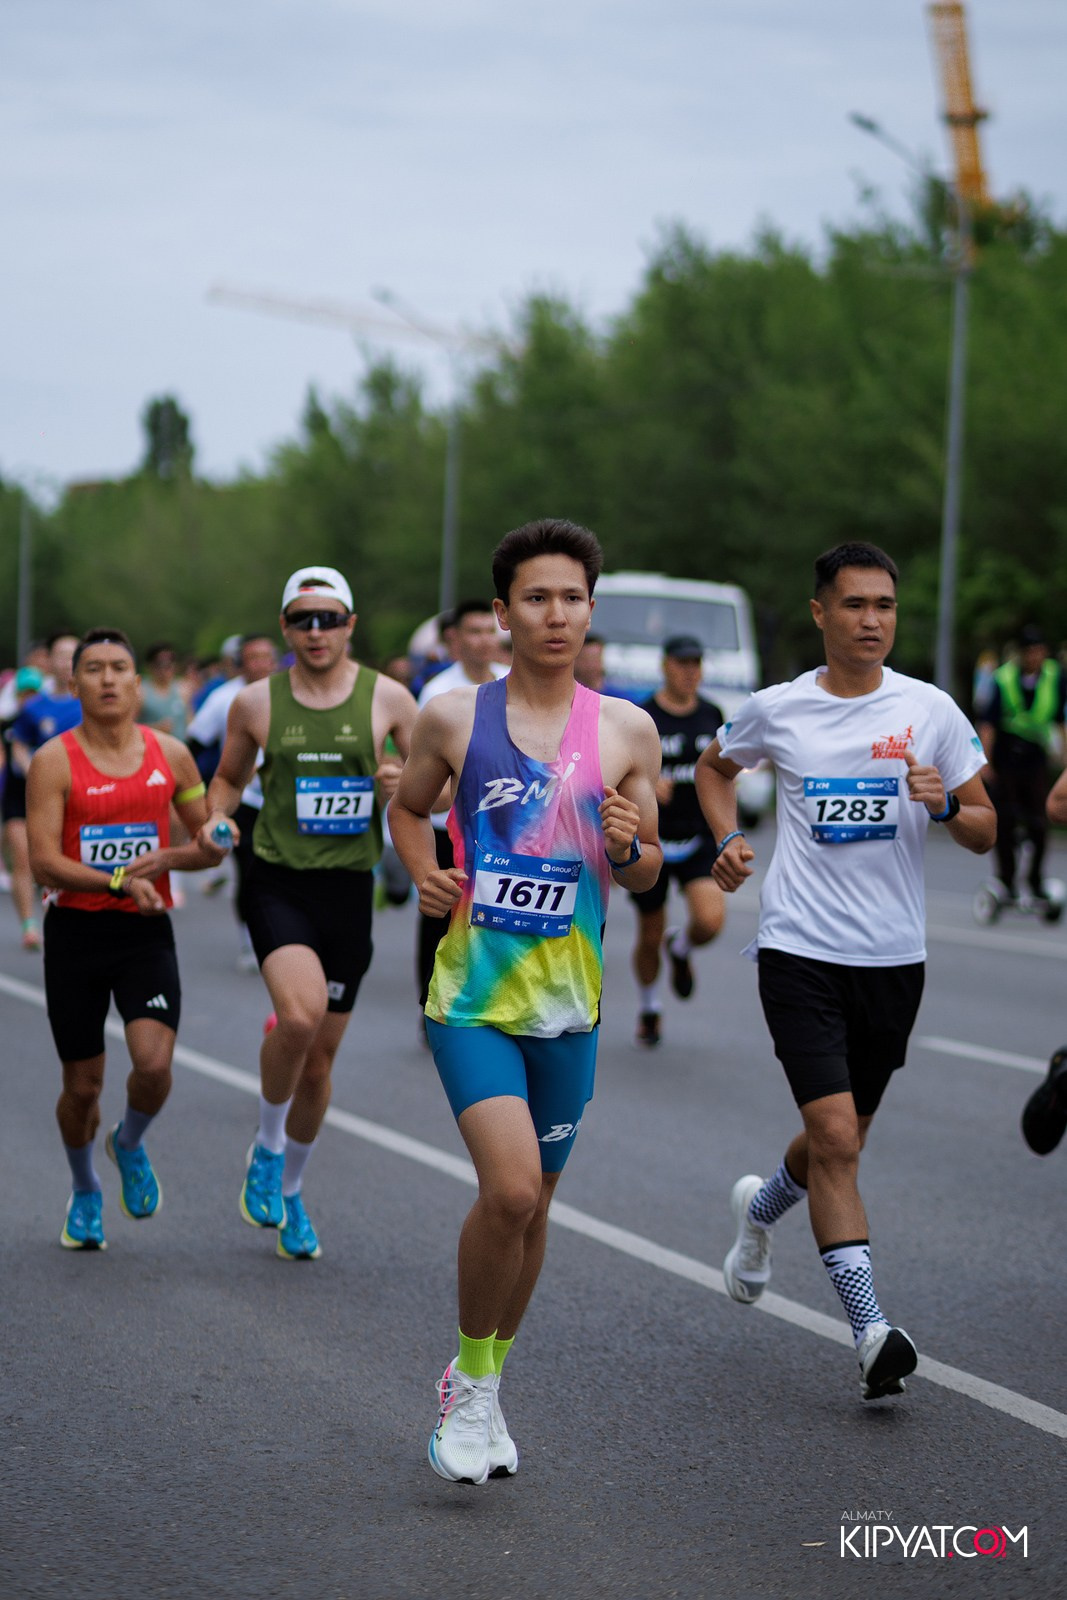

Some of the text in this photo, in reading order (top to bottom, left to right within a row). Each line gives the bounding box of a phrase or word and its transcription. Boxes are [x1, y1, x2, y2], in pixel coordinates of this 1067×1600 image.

[807, 781, 830, 790] 5 KM
[313, 796, 361, 815] 1121
[816, 799, 889, 822] 1283
[90, 841, 152, 862] 1050
[483, 853, 510, 866] 5 KM
[551, 866, 572, 874] GROUP
[495, 878, 567, 911] 1611
